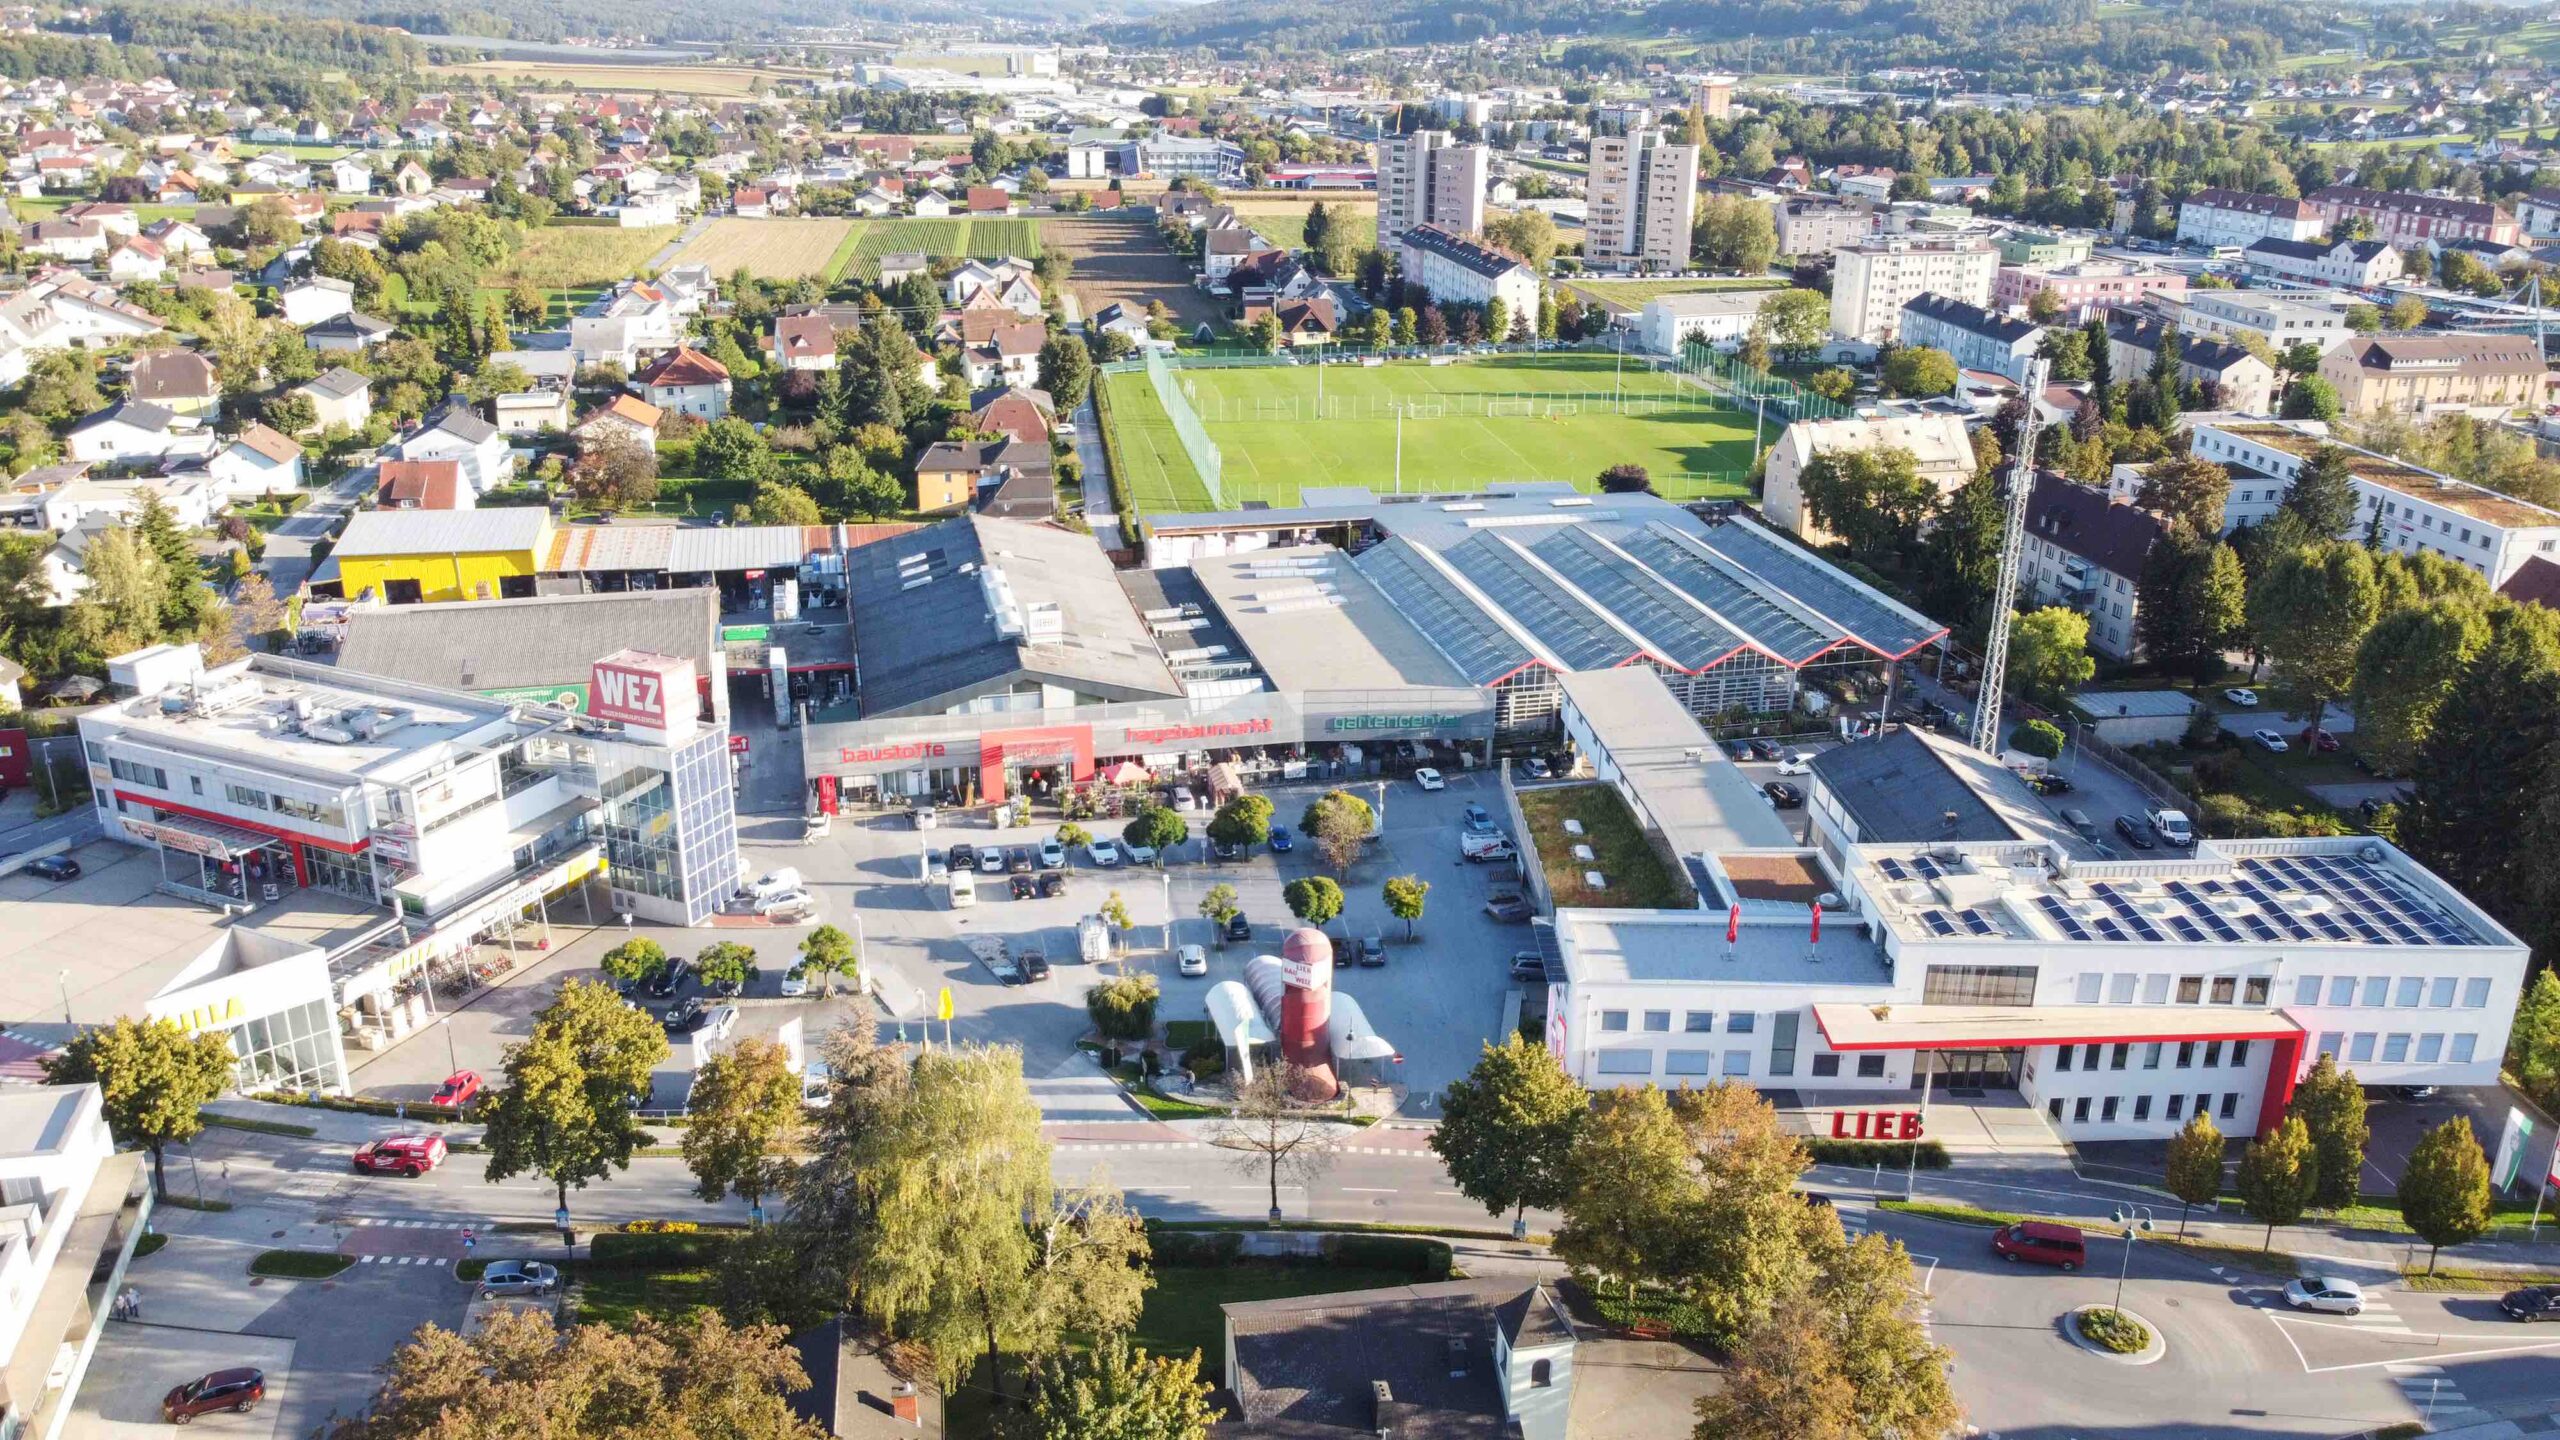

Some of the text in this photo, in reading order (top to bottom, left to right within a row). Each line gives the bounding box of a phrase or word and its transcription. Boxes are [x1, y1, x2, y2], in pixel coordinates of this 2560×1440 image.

[596, 668, 662, 714] WEZ
[1126, 718, 1273, 744] hagebaumarkt
[1334, 714, 1463, 731] gartencenter
[842, 742, 945, 763] baustoffe
[1832, 1110, 1924, 1140] LIEB
